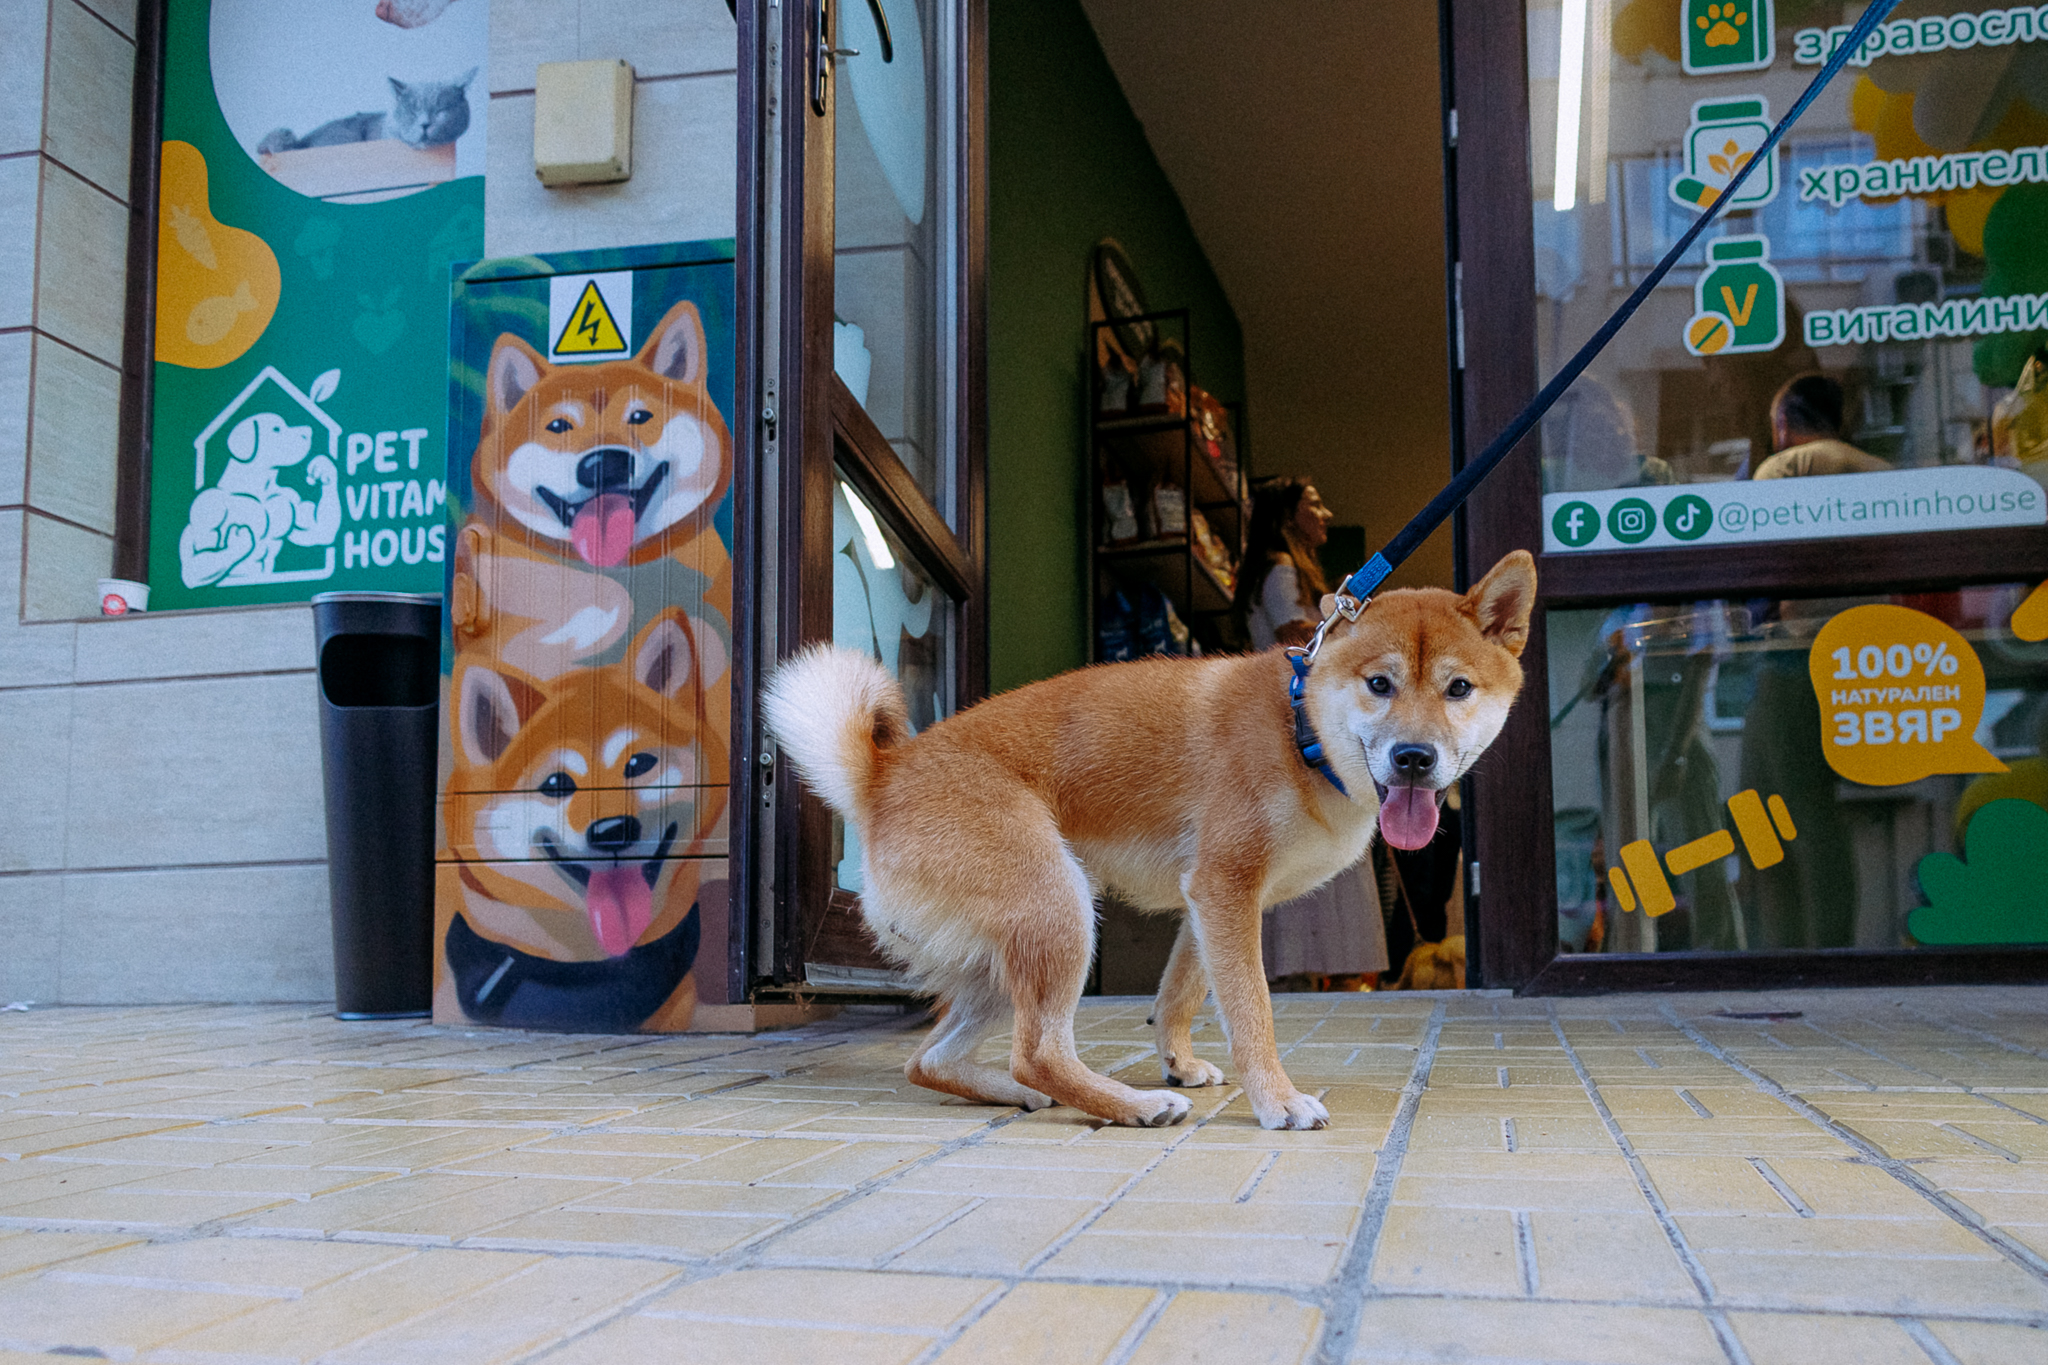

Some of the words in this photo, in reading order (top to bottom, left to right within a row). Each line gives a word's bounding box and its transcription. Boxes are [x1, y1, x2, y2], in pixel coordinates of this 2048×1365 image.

[1803, 148, 2048, 204] хранител
[1808, 297, 2048, 343] витамини
[346, 428, 428, 476] PET
[1717, 486, 2037, 534] @petvitaminhouse
[343, 524, 445, 569] HOUS
[1831, 641, 1959, 681] 100%
[1831, 684, 1961, 706] НАТУРАЛЕН
[1832, 707, 1962, 747] ЗВЯР
